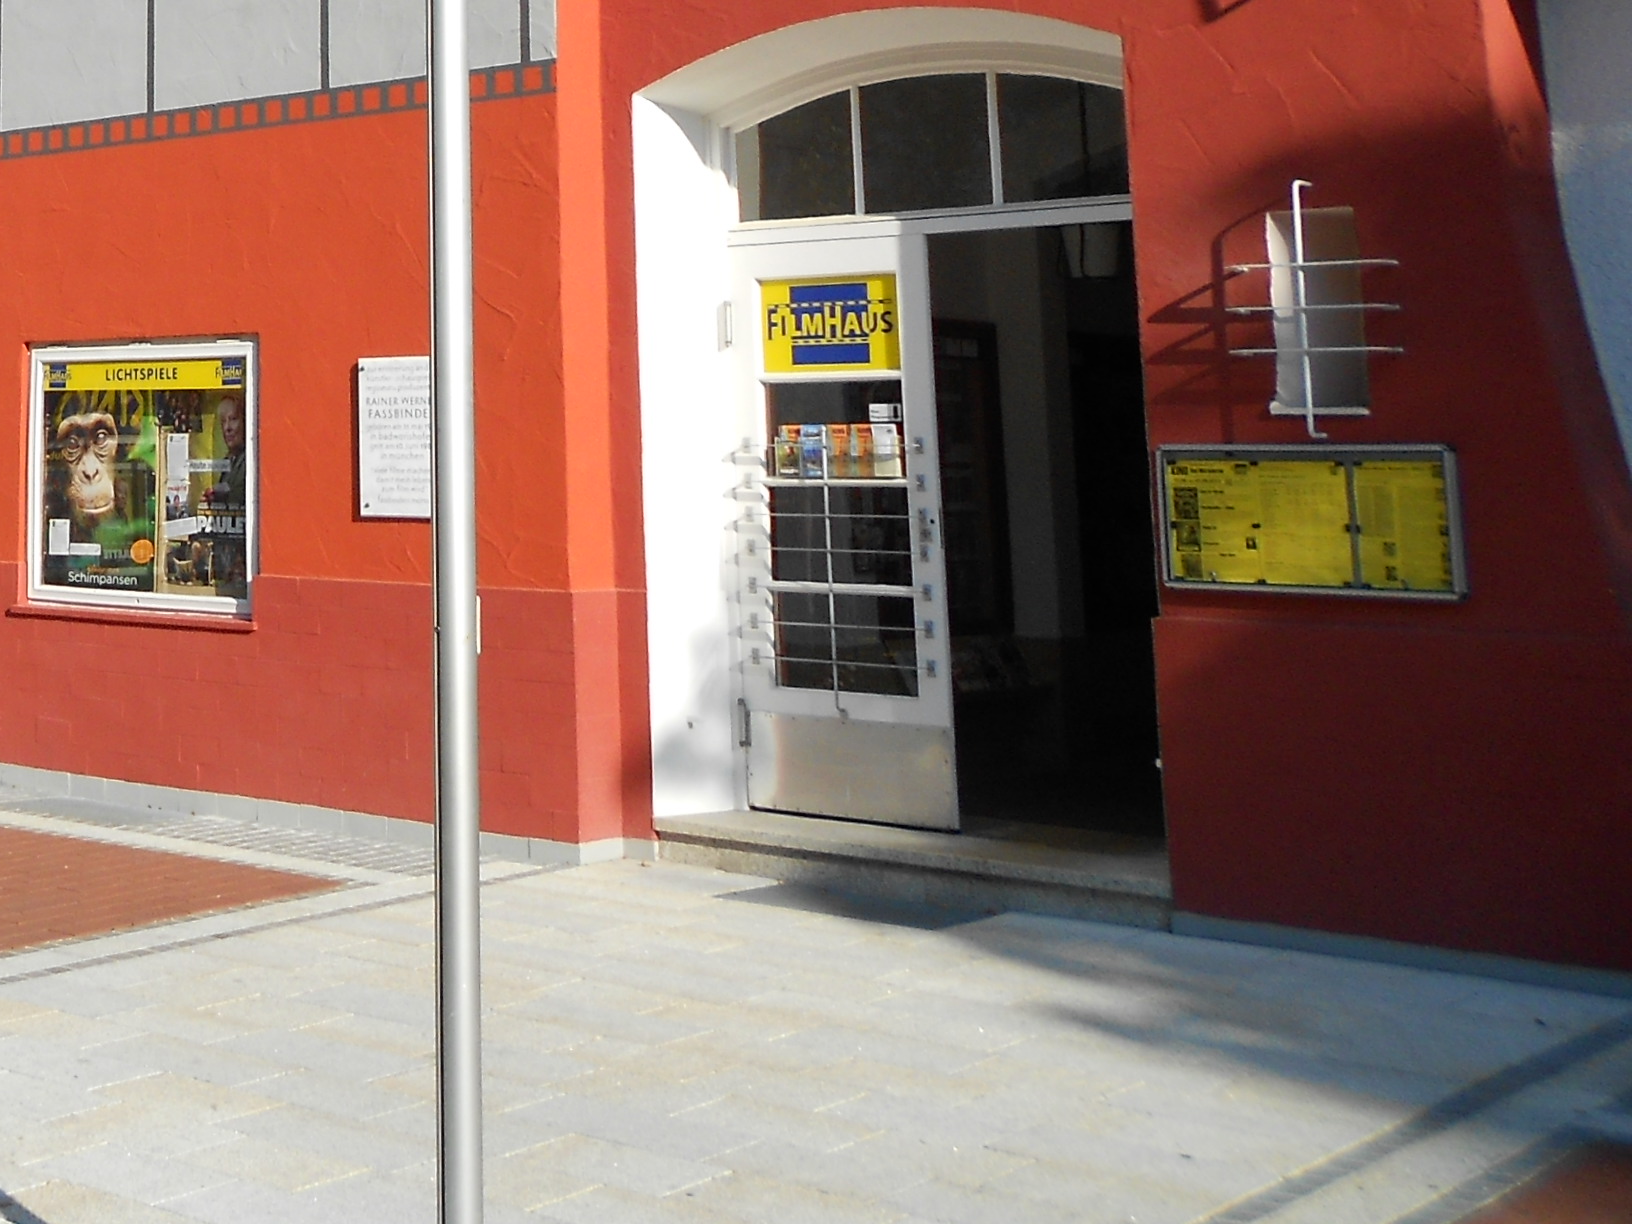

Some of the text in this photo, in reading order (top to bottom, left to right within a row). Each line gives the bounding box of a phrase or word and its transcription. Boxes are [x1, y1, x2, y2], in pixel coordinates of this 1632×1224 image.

[768, 304, 894, 341] FILMHAUS
[105, 368, 178, 381] LICHTSPIELE
[366, 397, 398, 406] RAINER
[197, 515, 245, 534] PAULE
[68, 571, 137, 585] Schimpansen
